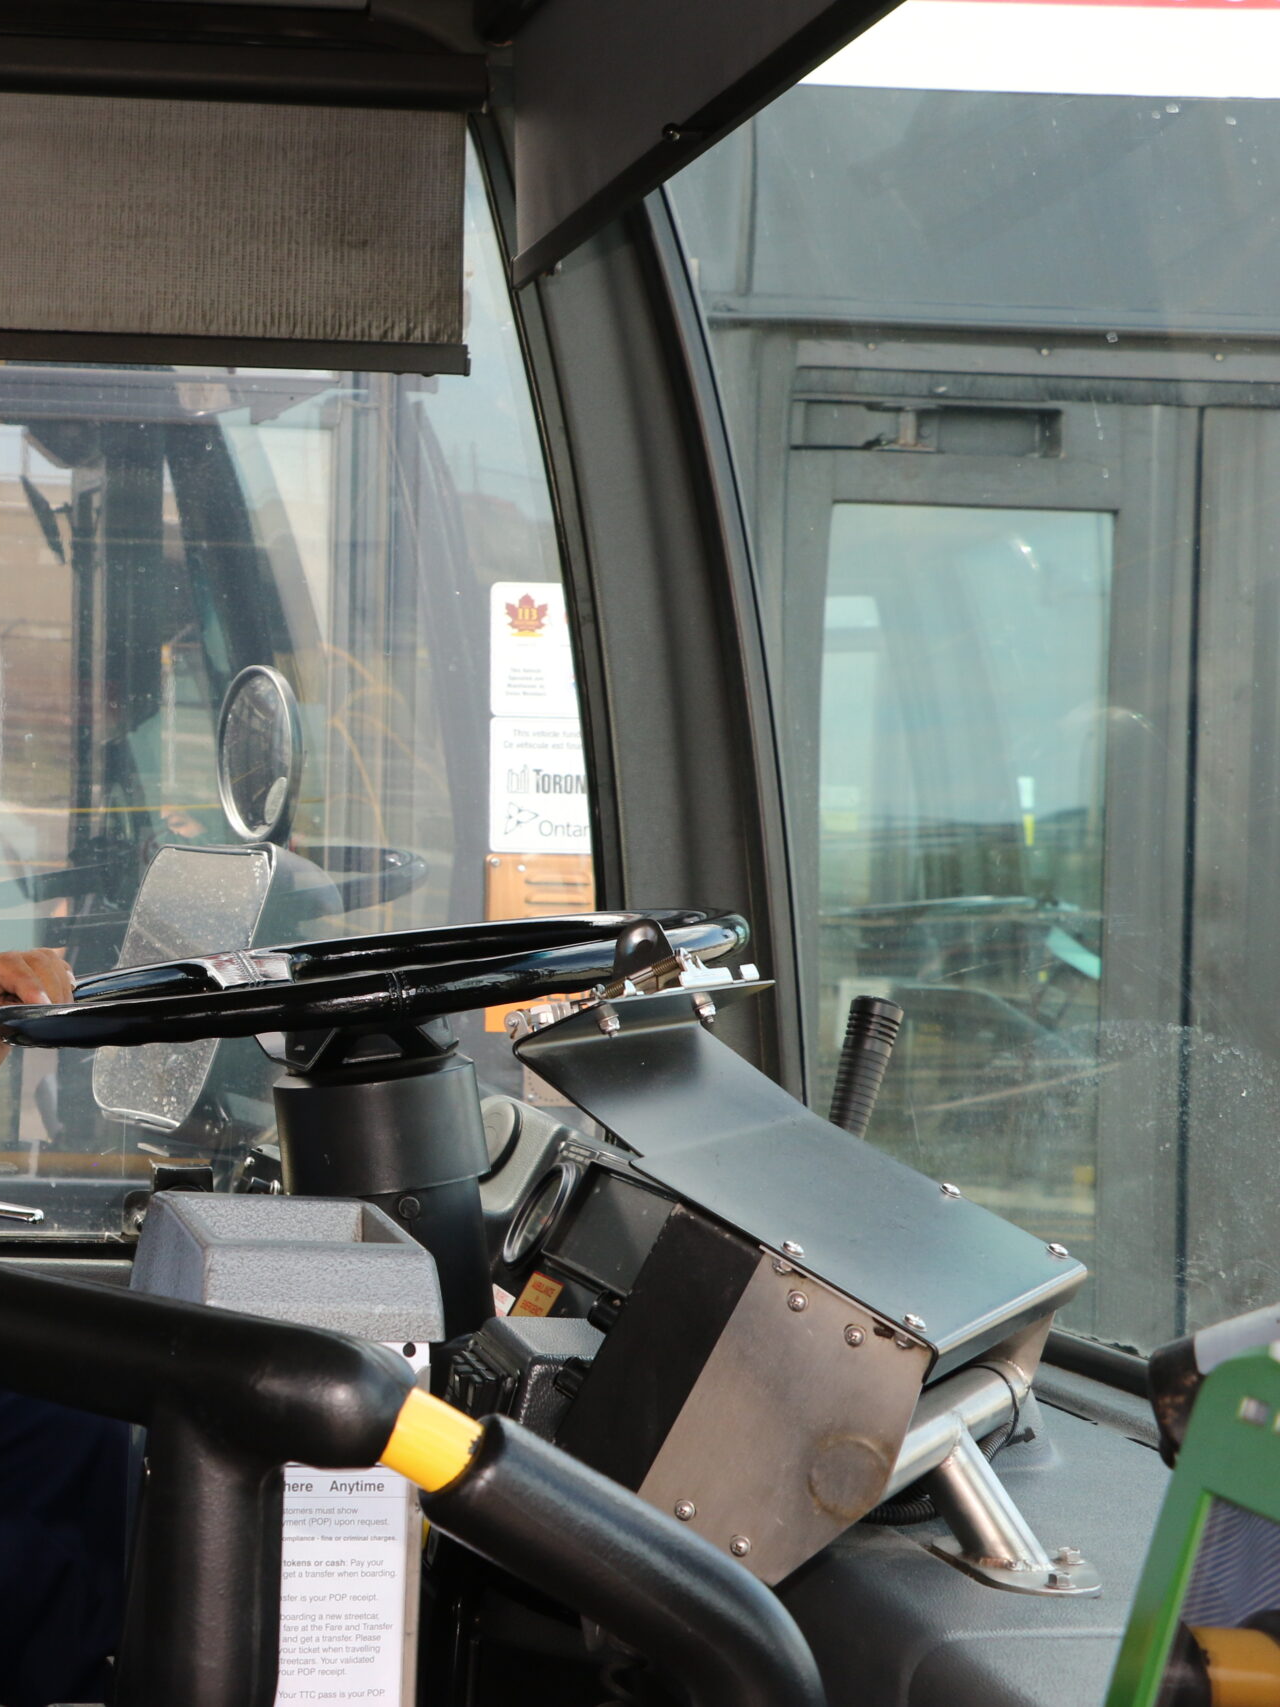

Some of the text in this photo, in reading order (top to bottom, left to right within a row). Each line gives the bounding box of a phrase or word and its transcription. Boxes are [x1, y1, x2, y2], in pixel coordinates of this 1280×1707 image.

[514, 729, 529, 738] This
[329, 1480, 385, 1495] Anytime
[315, 1507, 335, 1515] must
[337, 1507, 358, 1515] show
[308, 1518, 332, 1527] (POP)
[334, 1520, 355, 1528] upon
[357, 1518, 389, 1528] request.
[283, 1559, 312, 1567] tokens
[325, 1559, 347, 1567] cash:
[350, 1558, 365, 1568] Pay
[367, 1559, 384, 1568] your
[282, 1571, 296, 1580] get
[305, 1570, 335, 1578] transfer
[337, 1570, 359, 1578] when
[360, 1569, 398, 1579] boarding.
[309, 1594, 327, 1603] your
[328, 1593, 348, 1601] POP
[349, 1593, 379, 1603] receipt.
[283, 1624, 299, 1632] fare
[310, 1623, 323, 1631] the
[325, 1623, 343, 1631] Fare
[344, 1623, 361, 1631] and
[362, 1622, 393, 1631] Transfer
[282, 1634, 298, 1643] and
[300, 1635, 313, 1645] get
[322, 1634, 352, 1642] transfer.
[355, 1633, 382, 1642] Please
[298, 1645, 321, 1654] ticket
[322, 1645, 344, 1653] when
[345, 1644, 381, 1656] travelling
[320, 1656, 338, 1665] Your
[340, 1655, 375, 1664] validated
[297, 1667, 316, 1676] POP
[318, 1667, 347, 1677] receipt.
[279, 1690, 297, 1699] Your
[299, 1689, 316, 1699] TTC
[318, 1691, 337, 1700] pass
[339, 1690, 346, 1698] is
[348, 1690, 365, 1699] your
